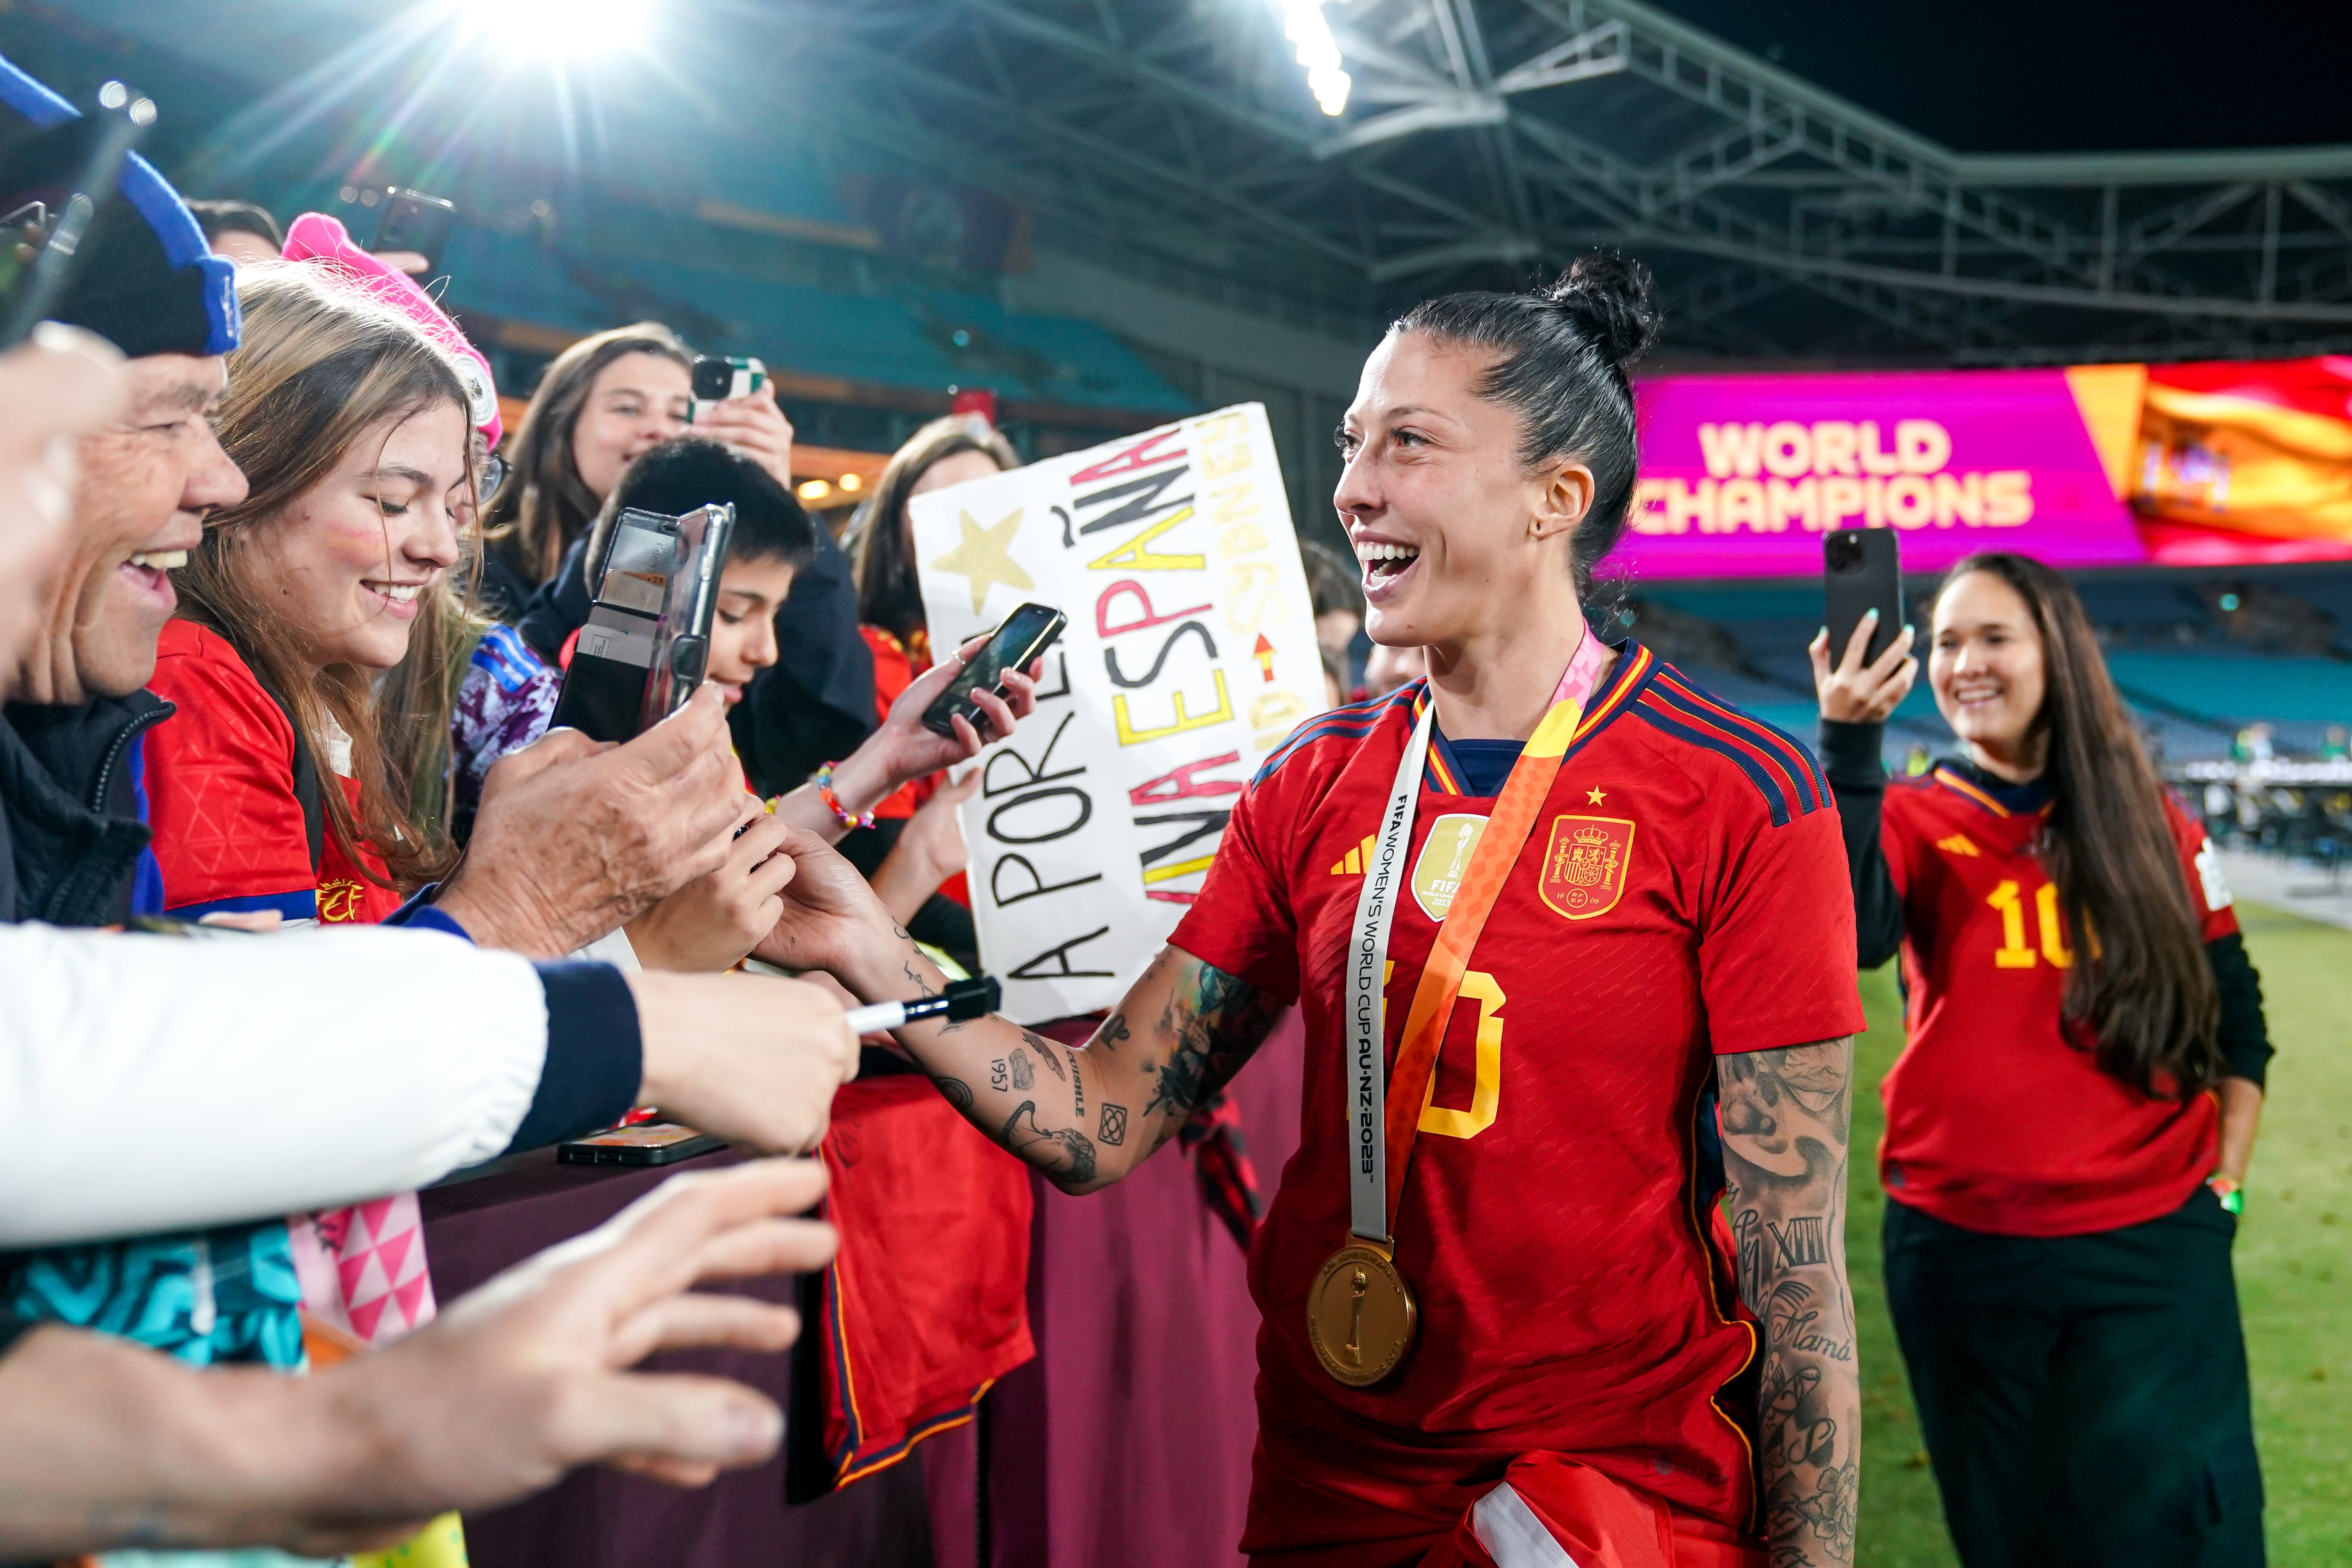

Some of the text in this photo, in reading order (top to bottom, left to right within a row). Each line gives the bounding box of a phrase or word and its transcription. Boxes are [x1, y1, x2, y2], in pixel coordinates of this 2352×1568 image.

[1697, 419, 1952, 478] WORLD
[1195, 412, 1288, 634] SYDNEY
[1627, 470, 2034, 535] CHAMPIONS
[1050, 427, 1243, 904] IVA ESPAÑA
[983, 712, 1102, 907] POR
[1389, 794, 1408, 832] FIFA
[1367, 832, 1397, 917] WOMEN'S
[1431, 898, 1451, 907] 2023
[1008, 926, 1113, 979] A
[1358, 920, 1379, 991] WORLD
[1358, 994, 1371, 1035] CUP
[991, 1059, 1008, 1092] 1957
